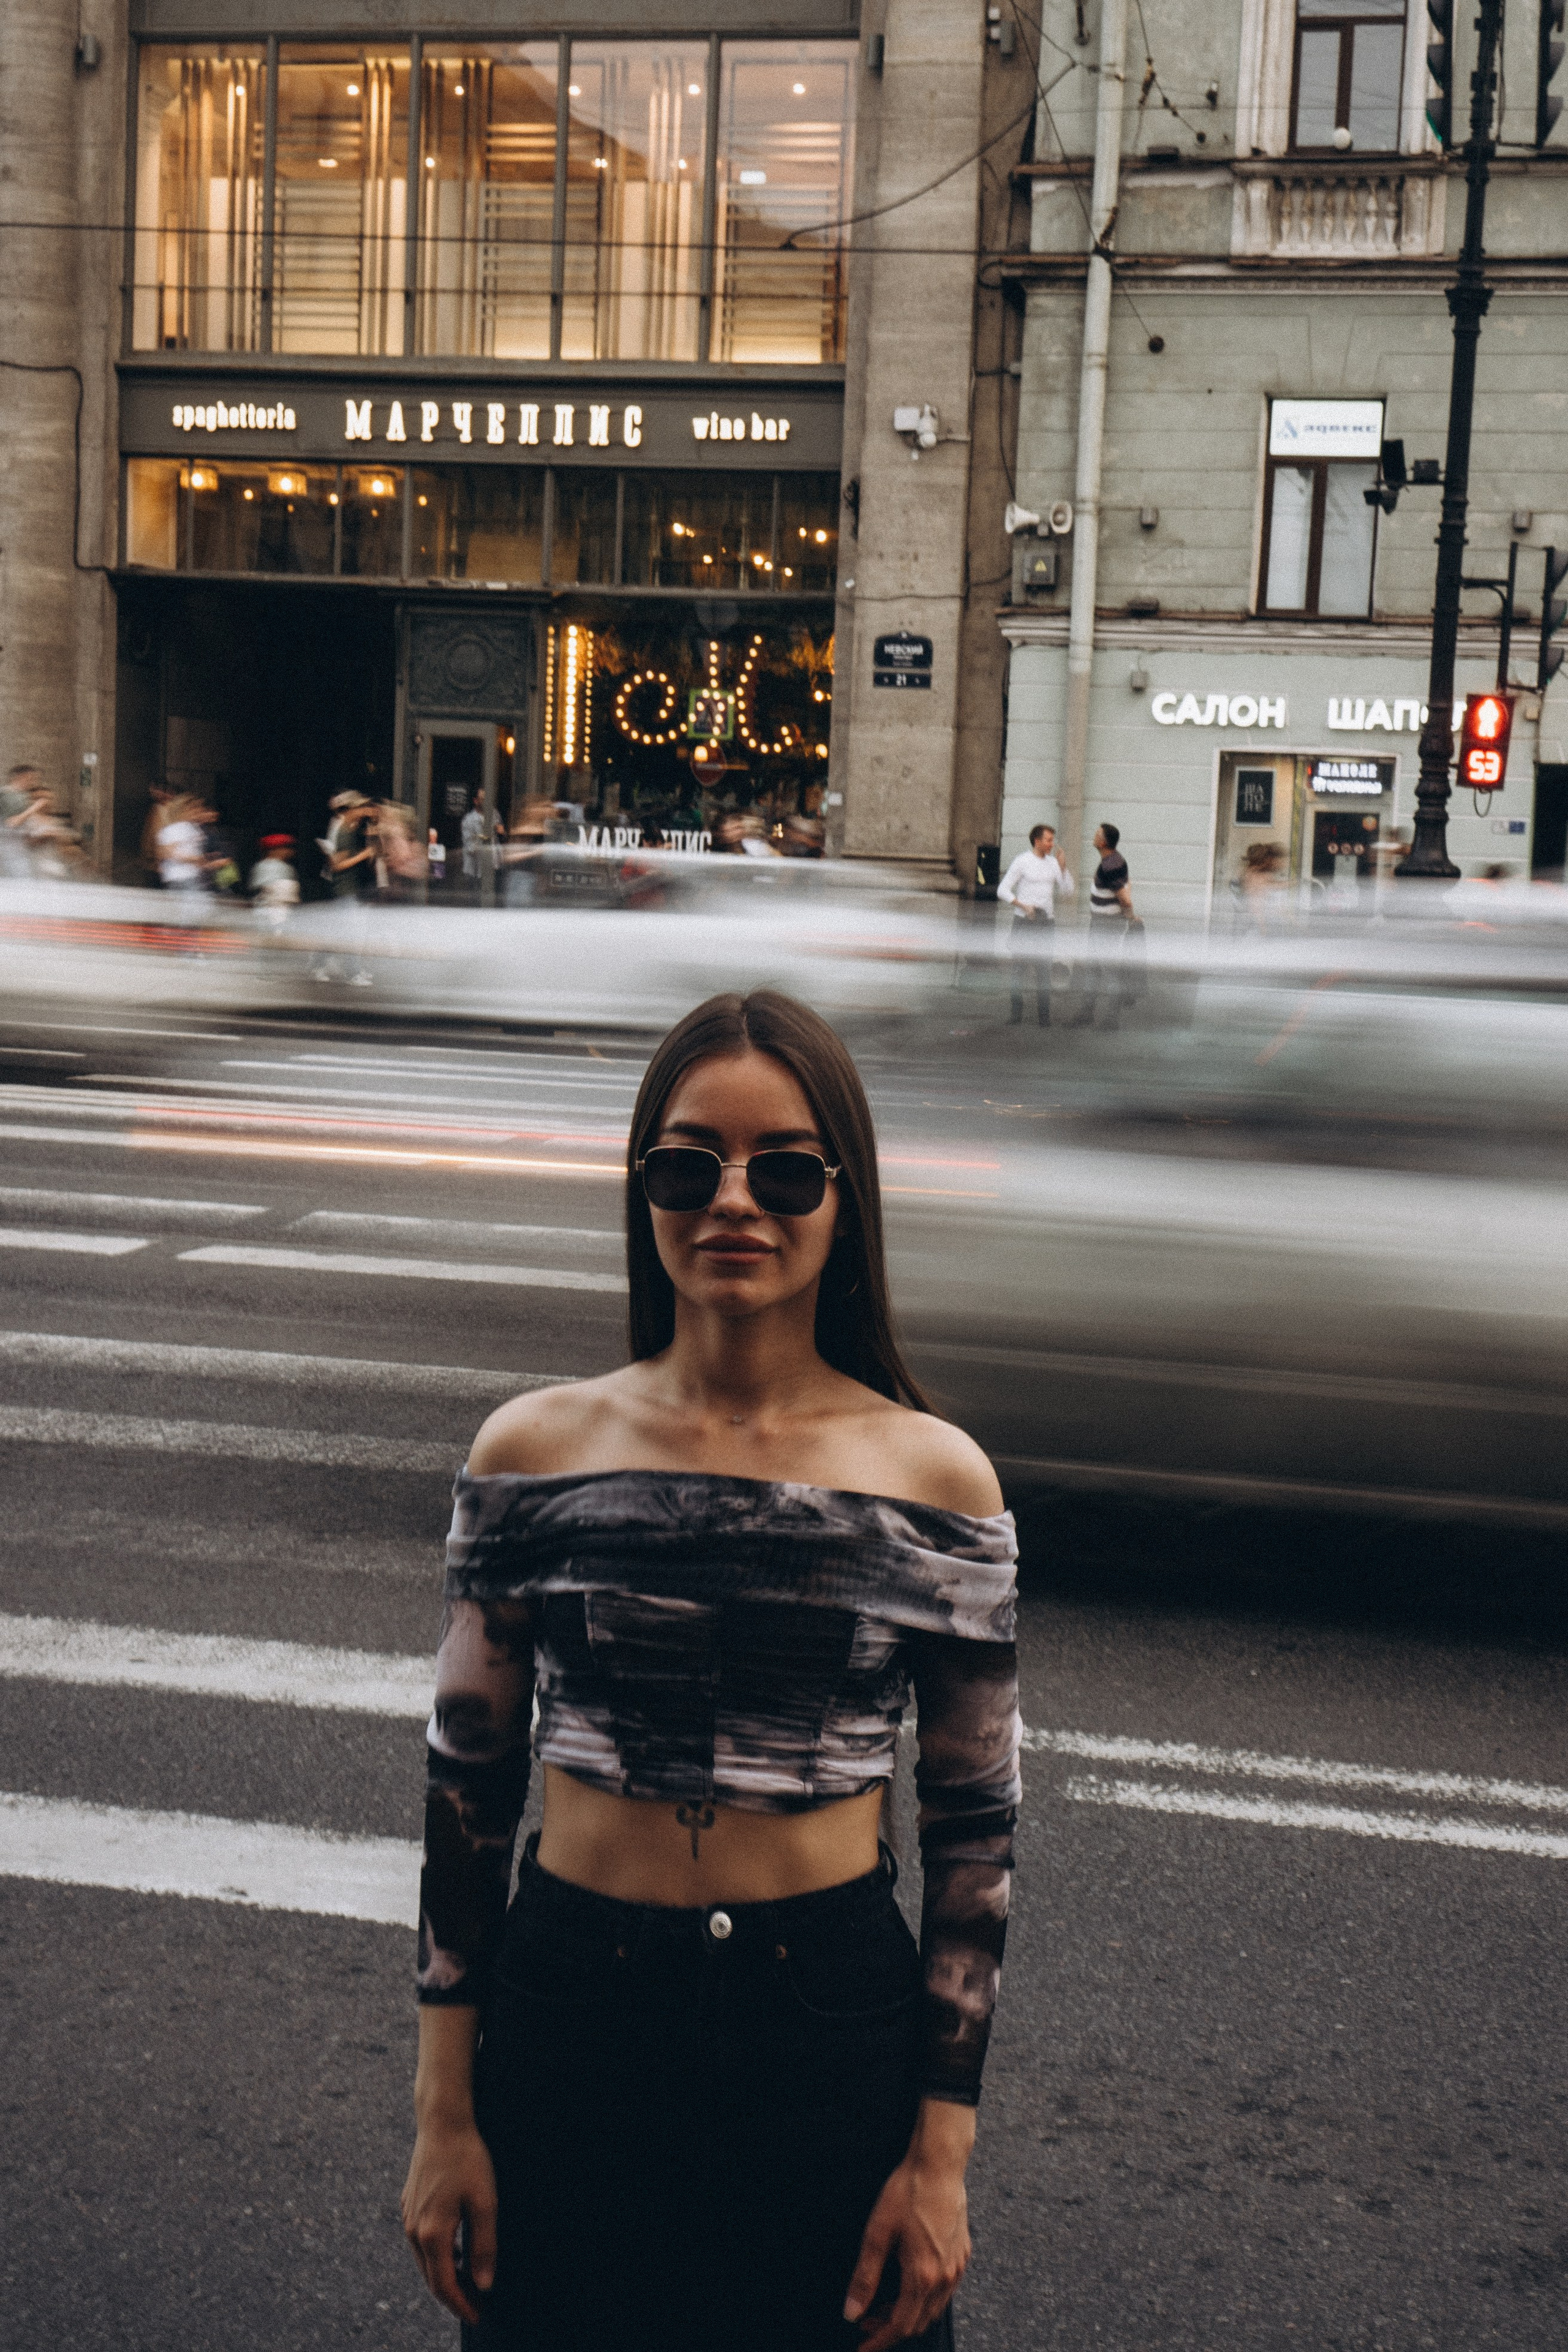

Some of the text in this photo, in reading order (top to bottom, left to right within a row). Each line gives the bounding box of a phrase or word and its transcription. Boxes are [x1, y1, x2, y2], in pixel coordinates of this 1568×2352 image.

[172, 400, 296, 432] spaghetteria
[345, 399, 643, 448] МАРЧЕЛЛИС
[751, 412, 790, 440] bar
[1152, 692, 1286, 729] САЛОН
[1468, 749, 1501, 783] 53
[578, 824, 712, 855] МАРЧЛИС
